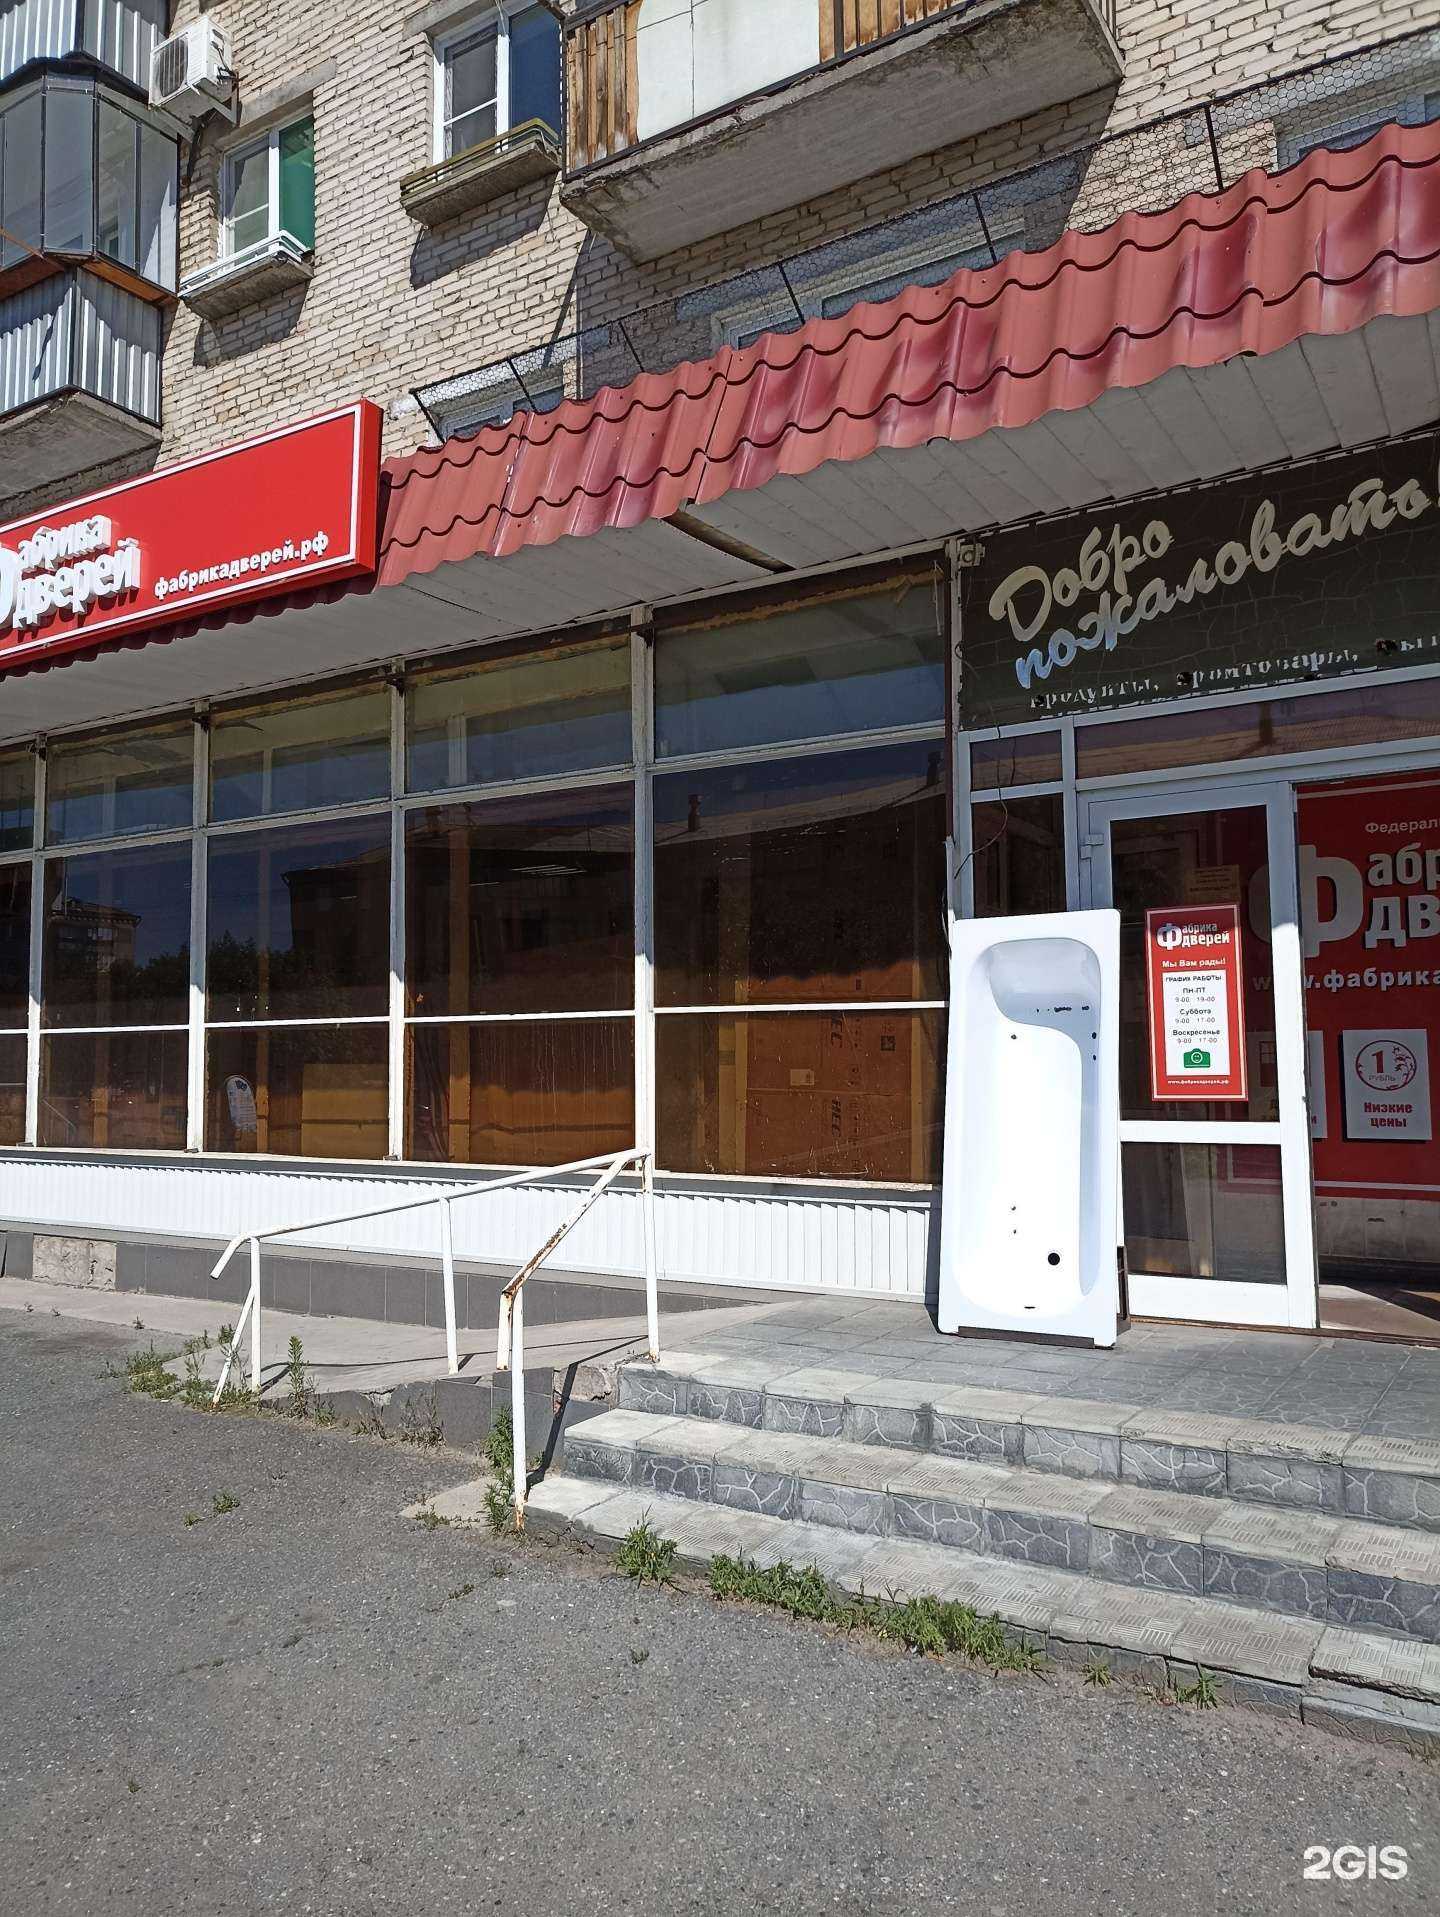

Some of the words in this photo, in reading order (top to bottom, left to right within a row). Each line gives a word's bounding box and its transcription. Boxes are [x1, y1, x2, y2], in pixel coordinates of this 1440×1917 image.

[154, 531, 329, 601] фабрикадверей.рф
[12, 537, 142, 629] дверей
[988, 519, 1175, 642] Добро
[1015, 463, 1440, 689] пожаловать
[1364, 817, 1440, 834] Федерал
[1181, 930, 1231, 948] дверей
[1162, 960, 1177, 968] Мы
[1179, 959, 1198, 968] Вам
[1192, 974, 1222, 982] РАБОТЫ
[1179, 1008, 1212, 1016] Суббота
[1371, 1050, 1385, 1074] 1
[1364, 1102, 1414, 1114] Низкие
[1370, 1116, 1408, 1129] цены
